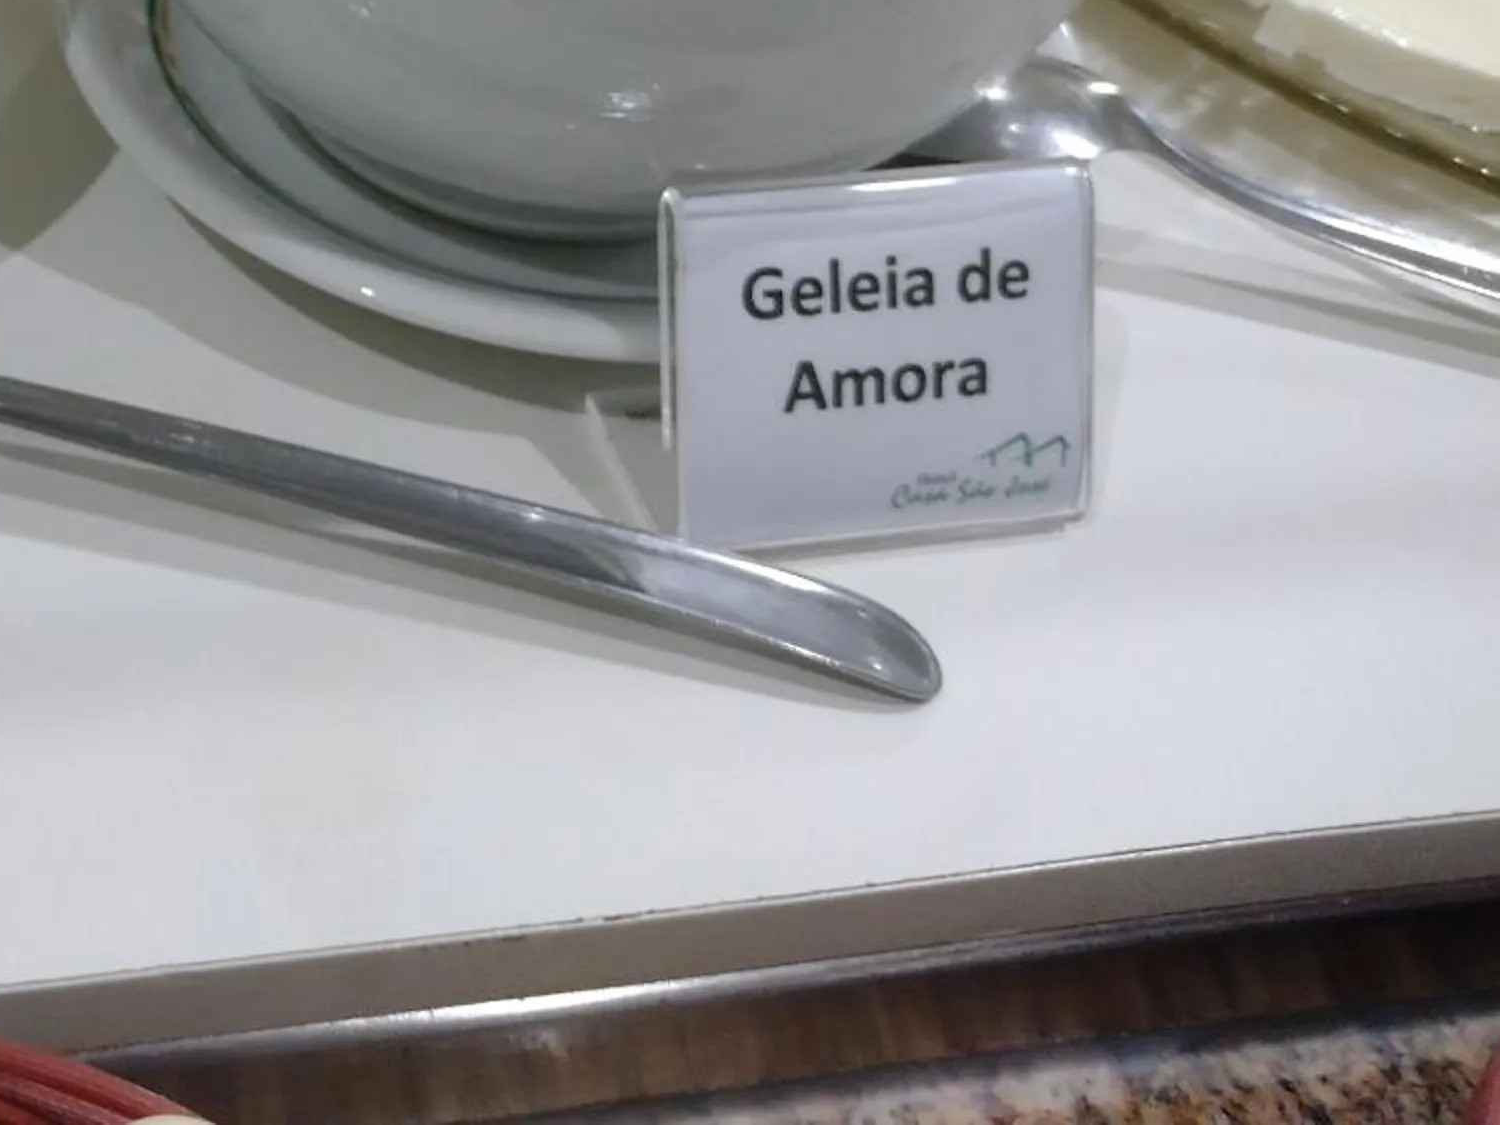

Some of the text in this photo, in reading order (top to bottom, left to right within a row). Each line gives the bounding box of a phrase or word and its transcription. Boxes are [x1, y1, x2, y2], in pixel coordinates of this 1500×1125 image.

[741, 246, 1031, 321] Geleia de
[783, 355, 988, 414] Amora
